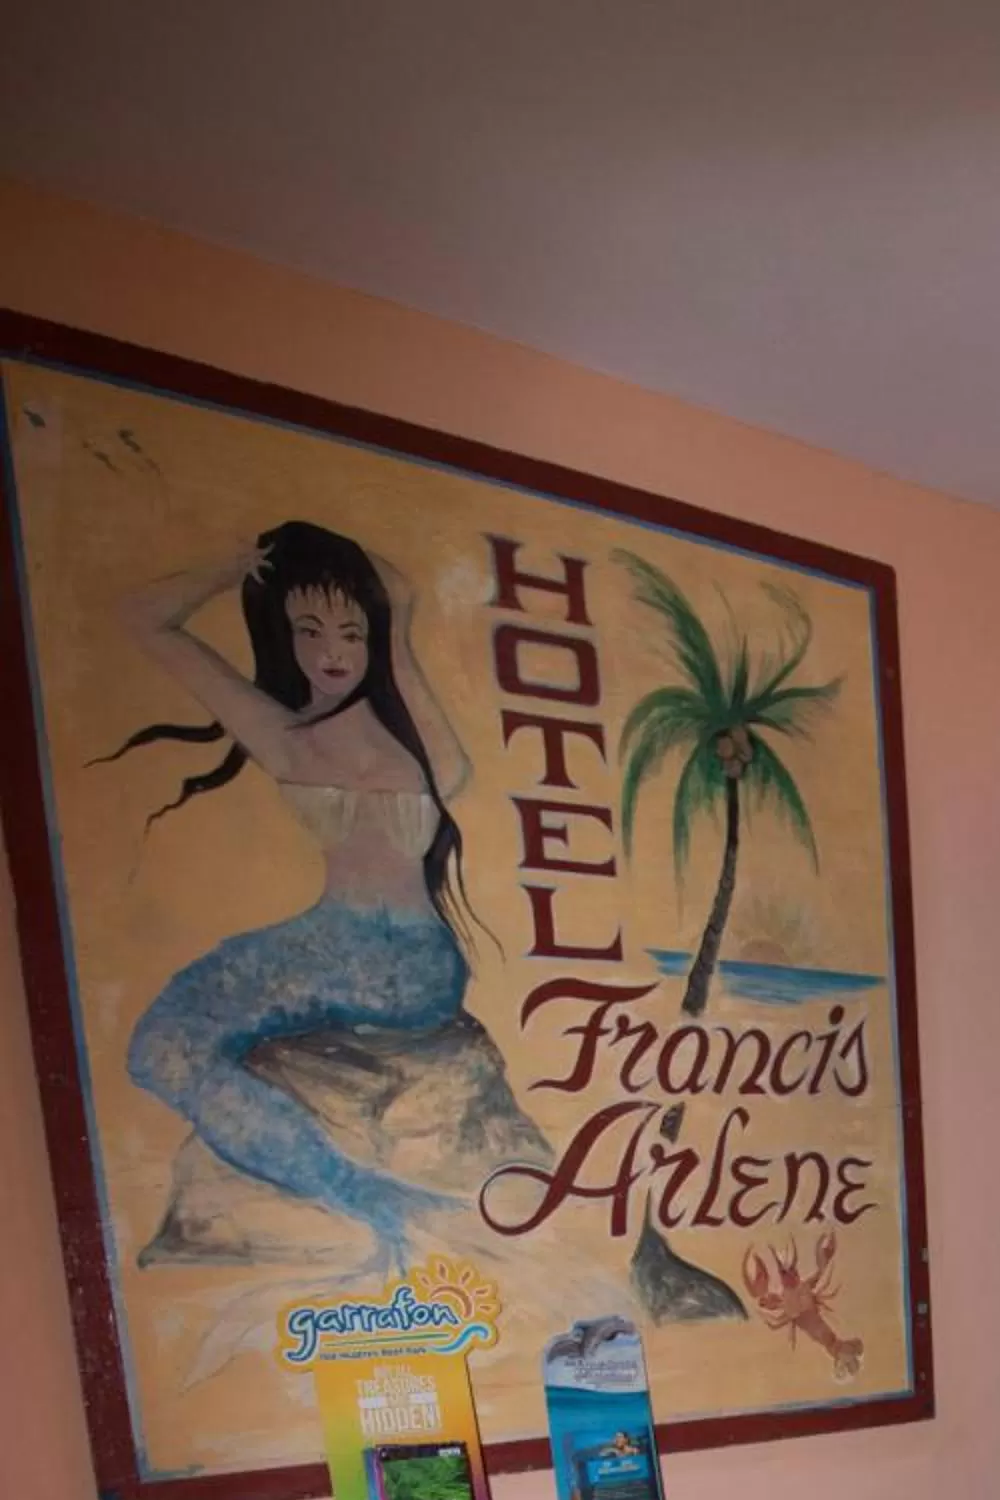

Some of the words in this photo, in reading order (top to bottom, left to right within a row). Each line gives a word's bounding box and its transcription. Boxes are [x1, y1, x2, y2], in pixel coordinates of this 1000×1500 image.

[484, 532, 624, 962] HOTEL
[519, 976, 870, 1097] Francis
[478, 1100, 878, 1237] Arlene
[286, 1284, 460, 1363] garrafon
